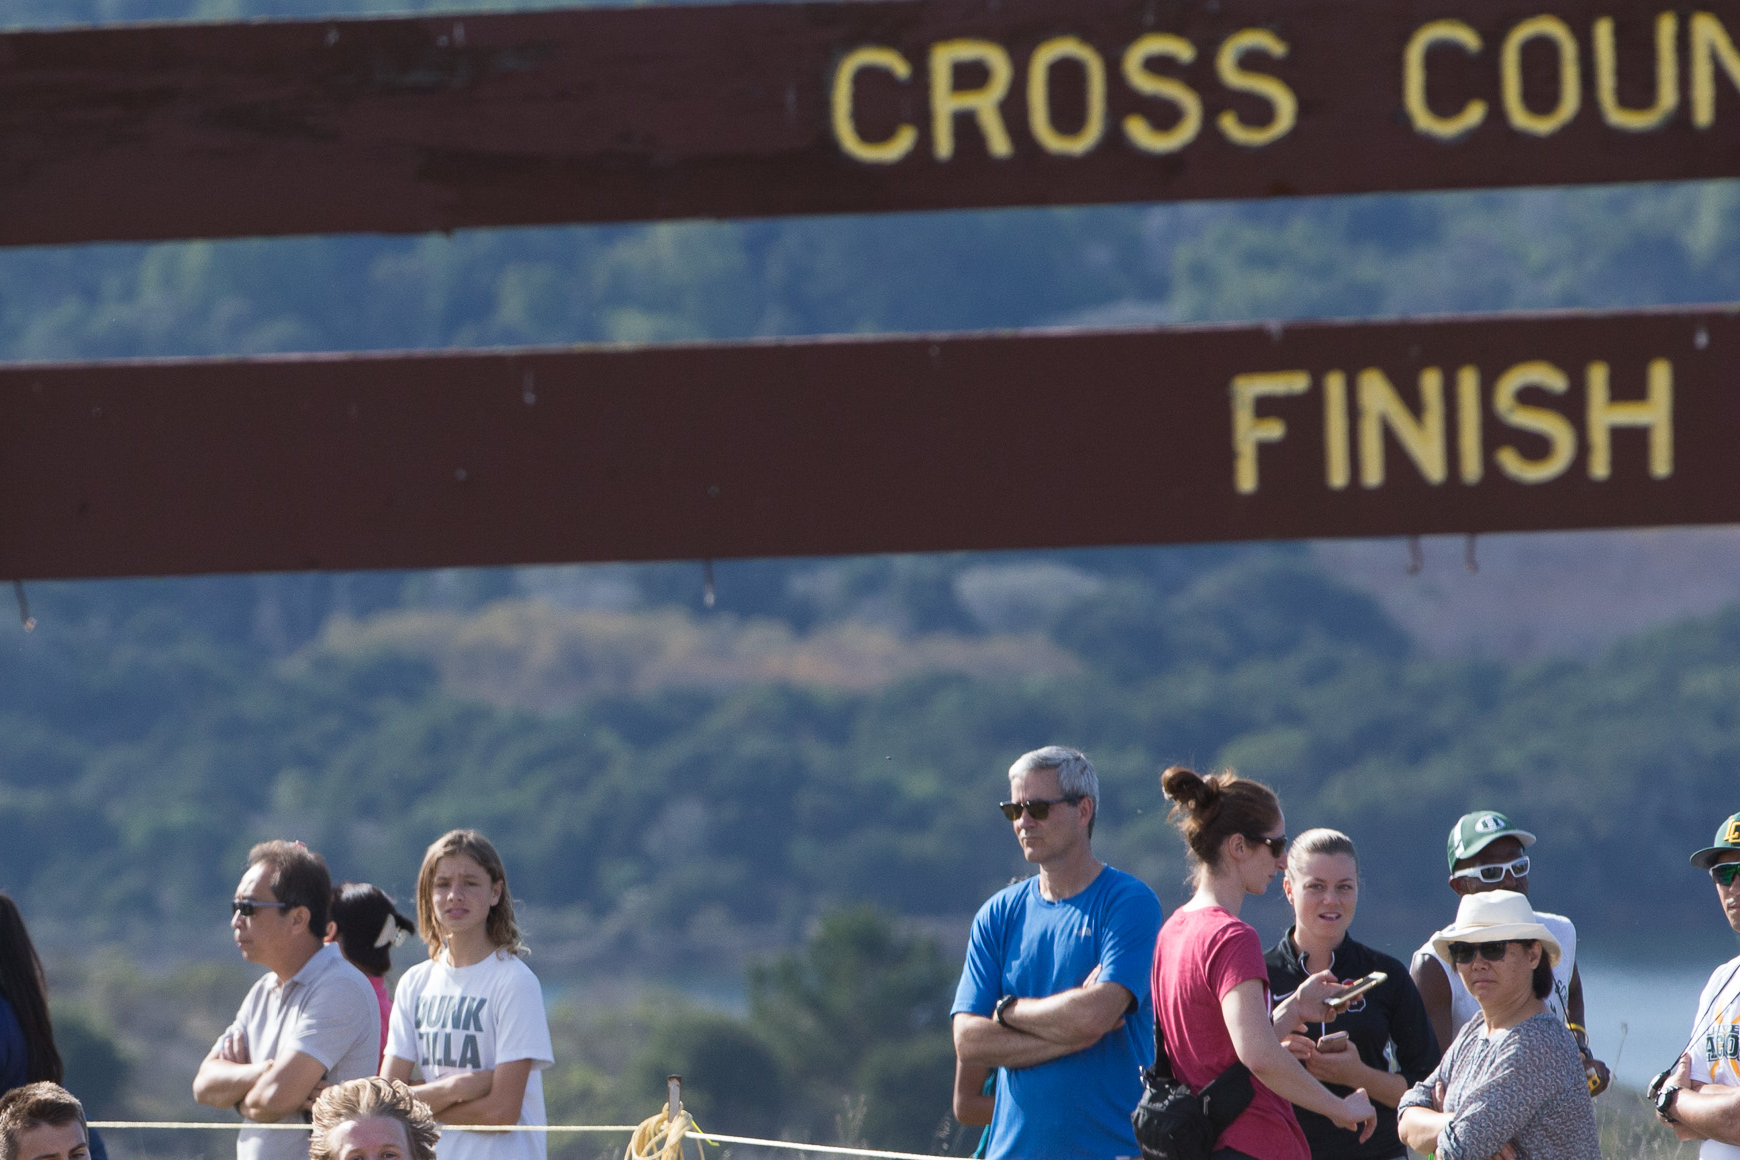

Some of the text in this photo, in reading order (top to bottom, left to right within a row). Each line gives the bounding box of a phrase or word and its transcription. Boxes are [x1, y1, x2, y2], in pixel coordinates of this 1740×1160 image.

[832, 10, 1740, 163] CROSS COUN
[1230, 357, 1674, 494] FINISH
[415, 995, 487, 1032] DUNK
